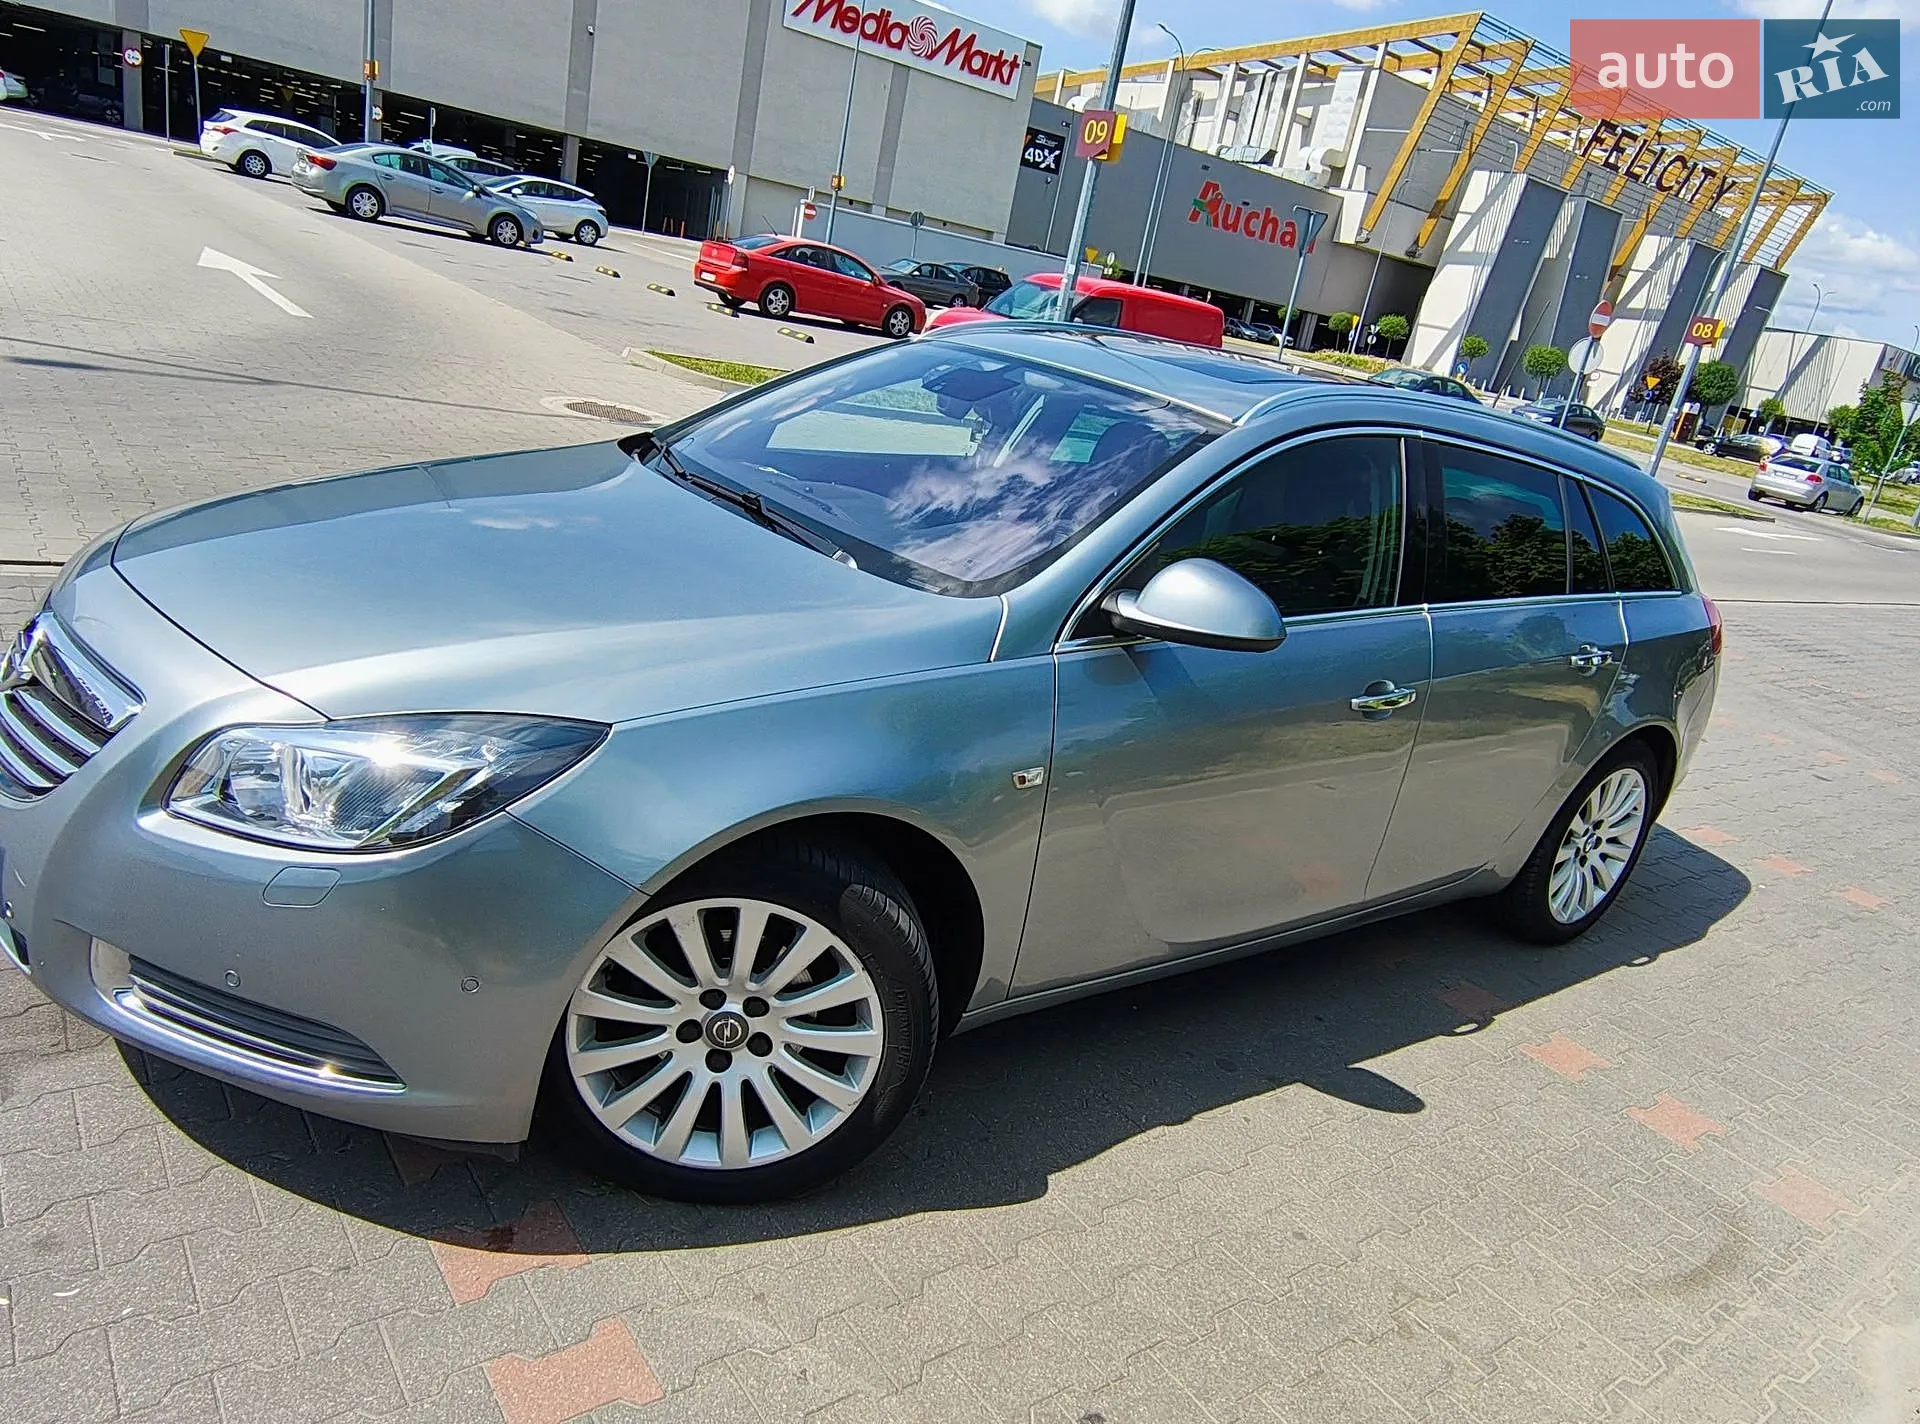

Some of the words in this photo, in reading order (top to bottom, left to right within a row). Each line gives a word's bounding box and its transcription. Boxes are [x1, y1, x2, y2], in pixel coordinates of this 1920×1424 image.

[791, 0, 909, 50] Media
[925, 28, 1020, 86] Markt
[1084, 119, 1108, 144] 09
[1024, 147, 1061, 169] 4DX
[1579, 118, 1737, 212] FELICITY
[1188, 180, 1316, 254] Aucha
[1692, 322, 1713, 338] 08
